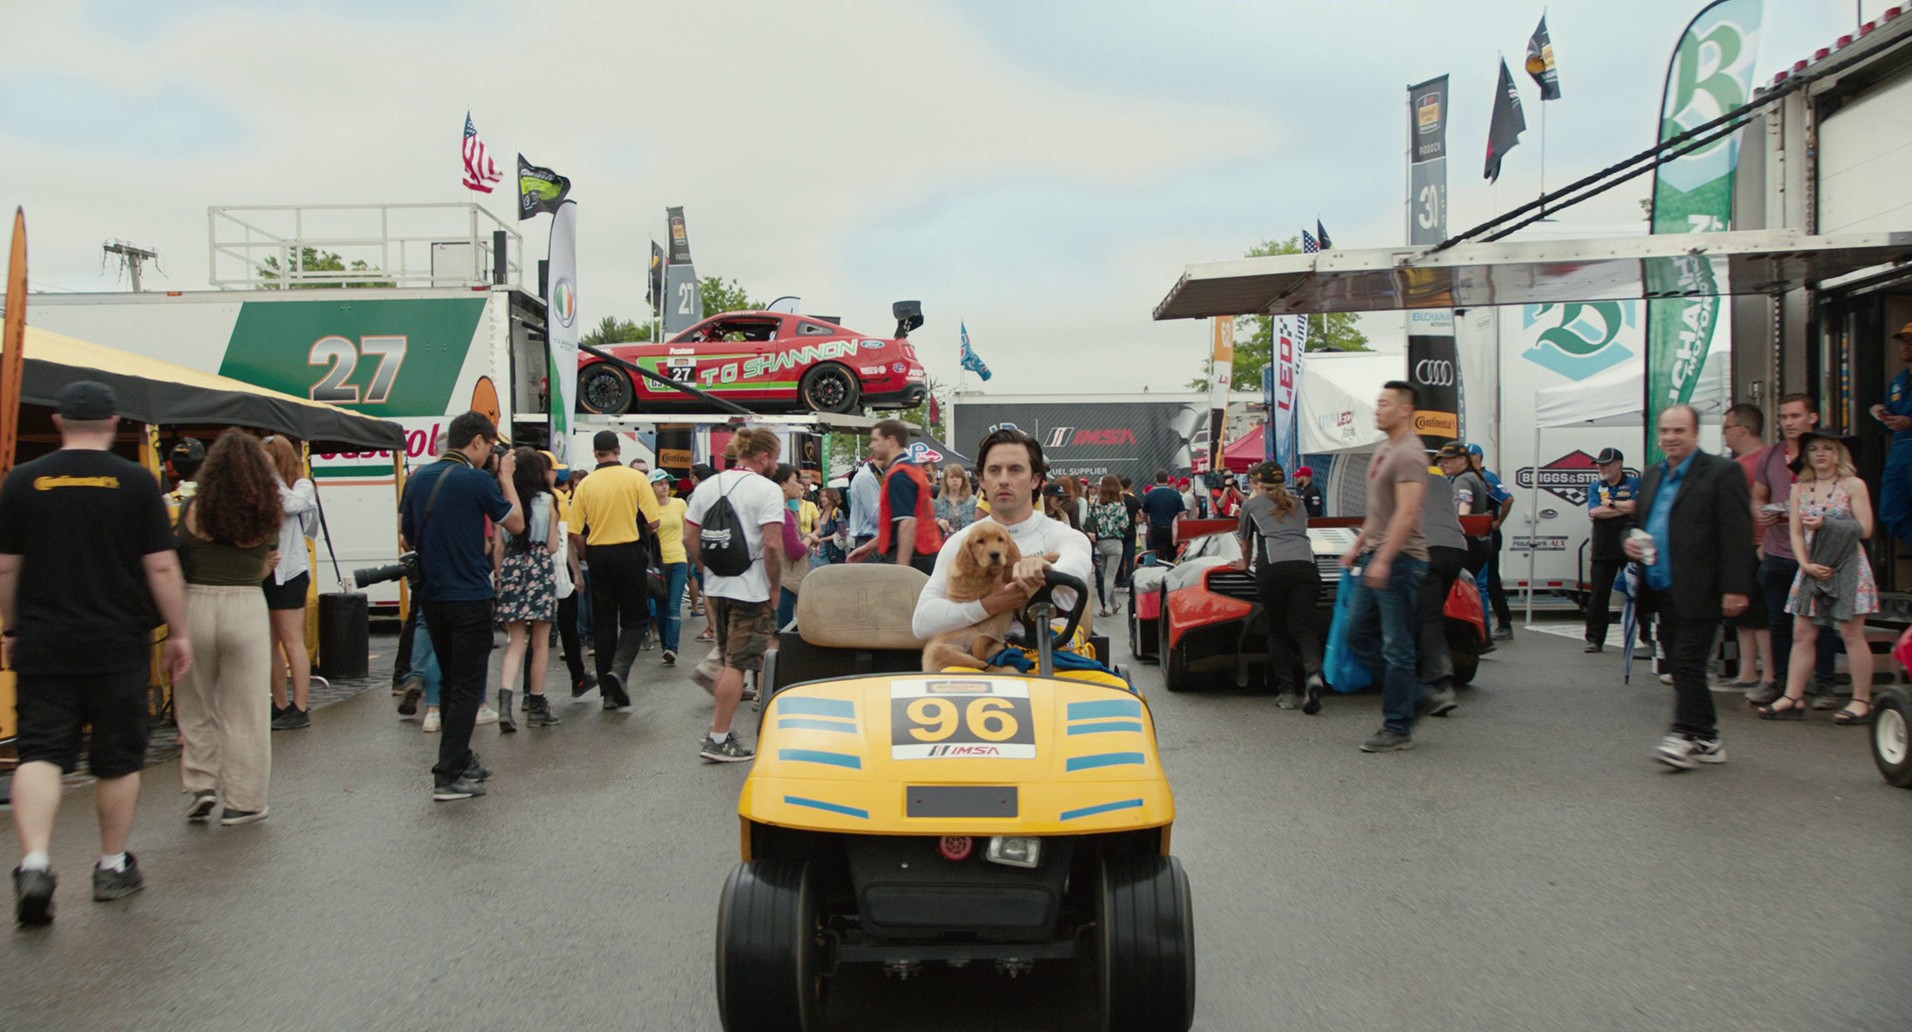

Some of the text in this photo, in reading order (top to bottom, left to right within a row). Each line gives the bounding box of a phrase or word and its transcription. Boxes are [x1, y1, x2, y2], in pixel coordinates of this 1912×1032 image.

[678, 282, 694, 315] 27
[308, 334, 407, 404] 27
[672, 367, 692, 382] 27
[743, 338, 858, 379] SHANNON
[1277, 336, 1293, 412] LED
[1069, 467, 1108, 476] SUPPLIER
[906, 696, 1020, 742] 96
[951, 746, 1000, 756] IMSA
